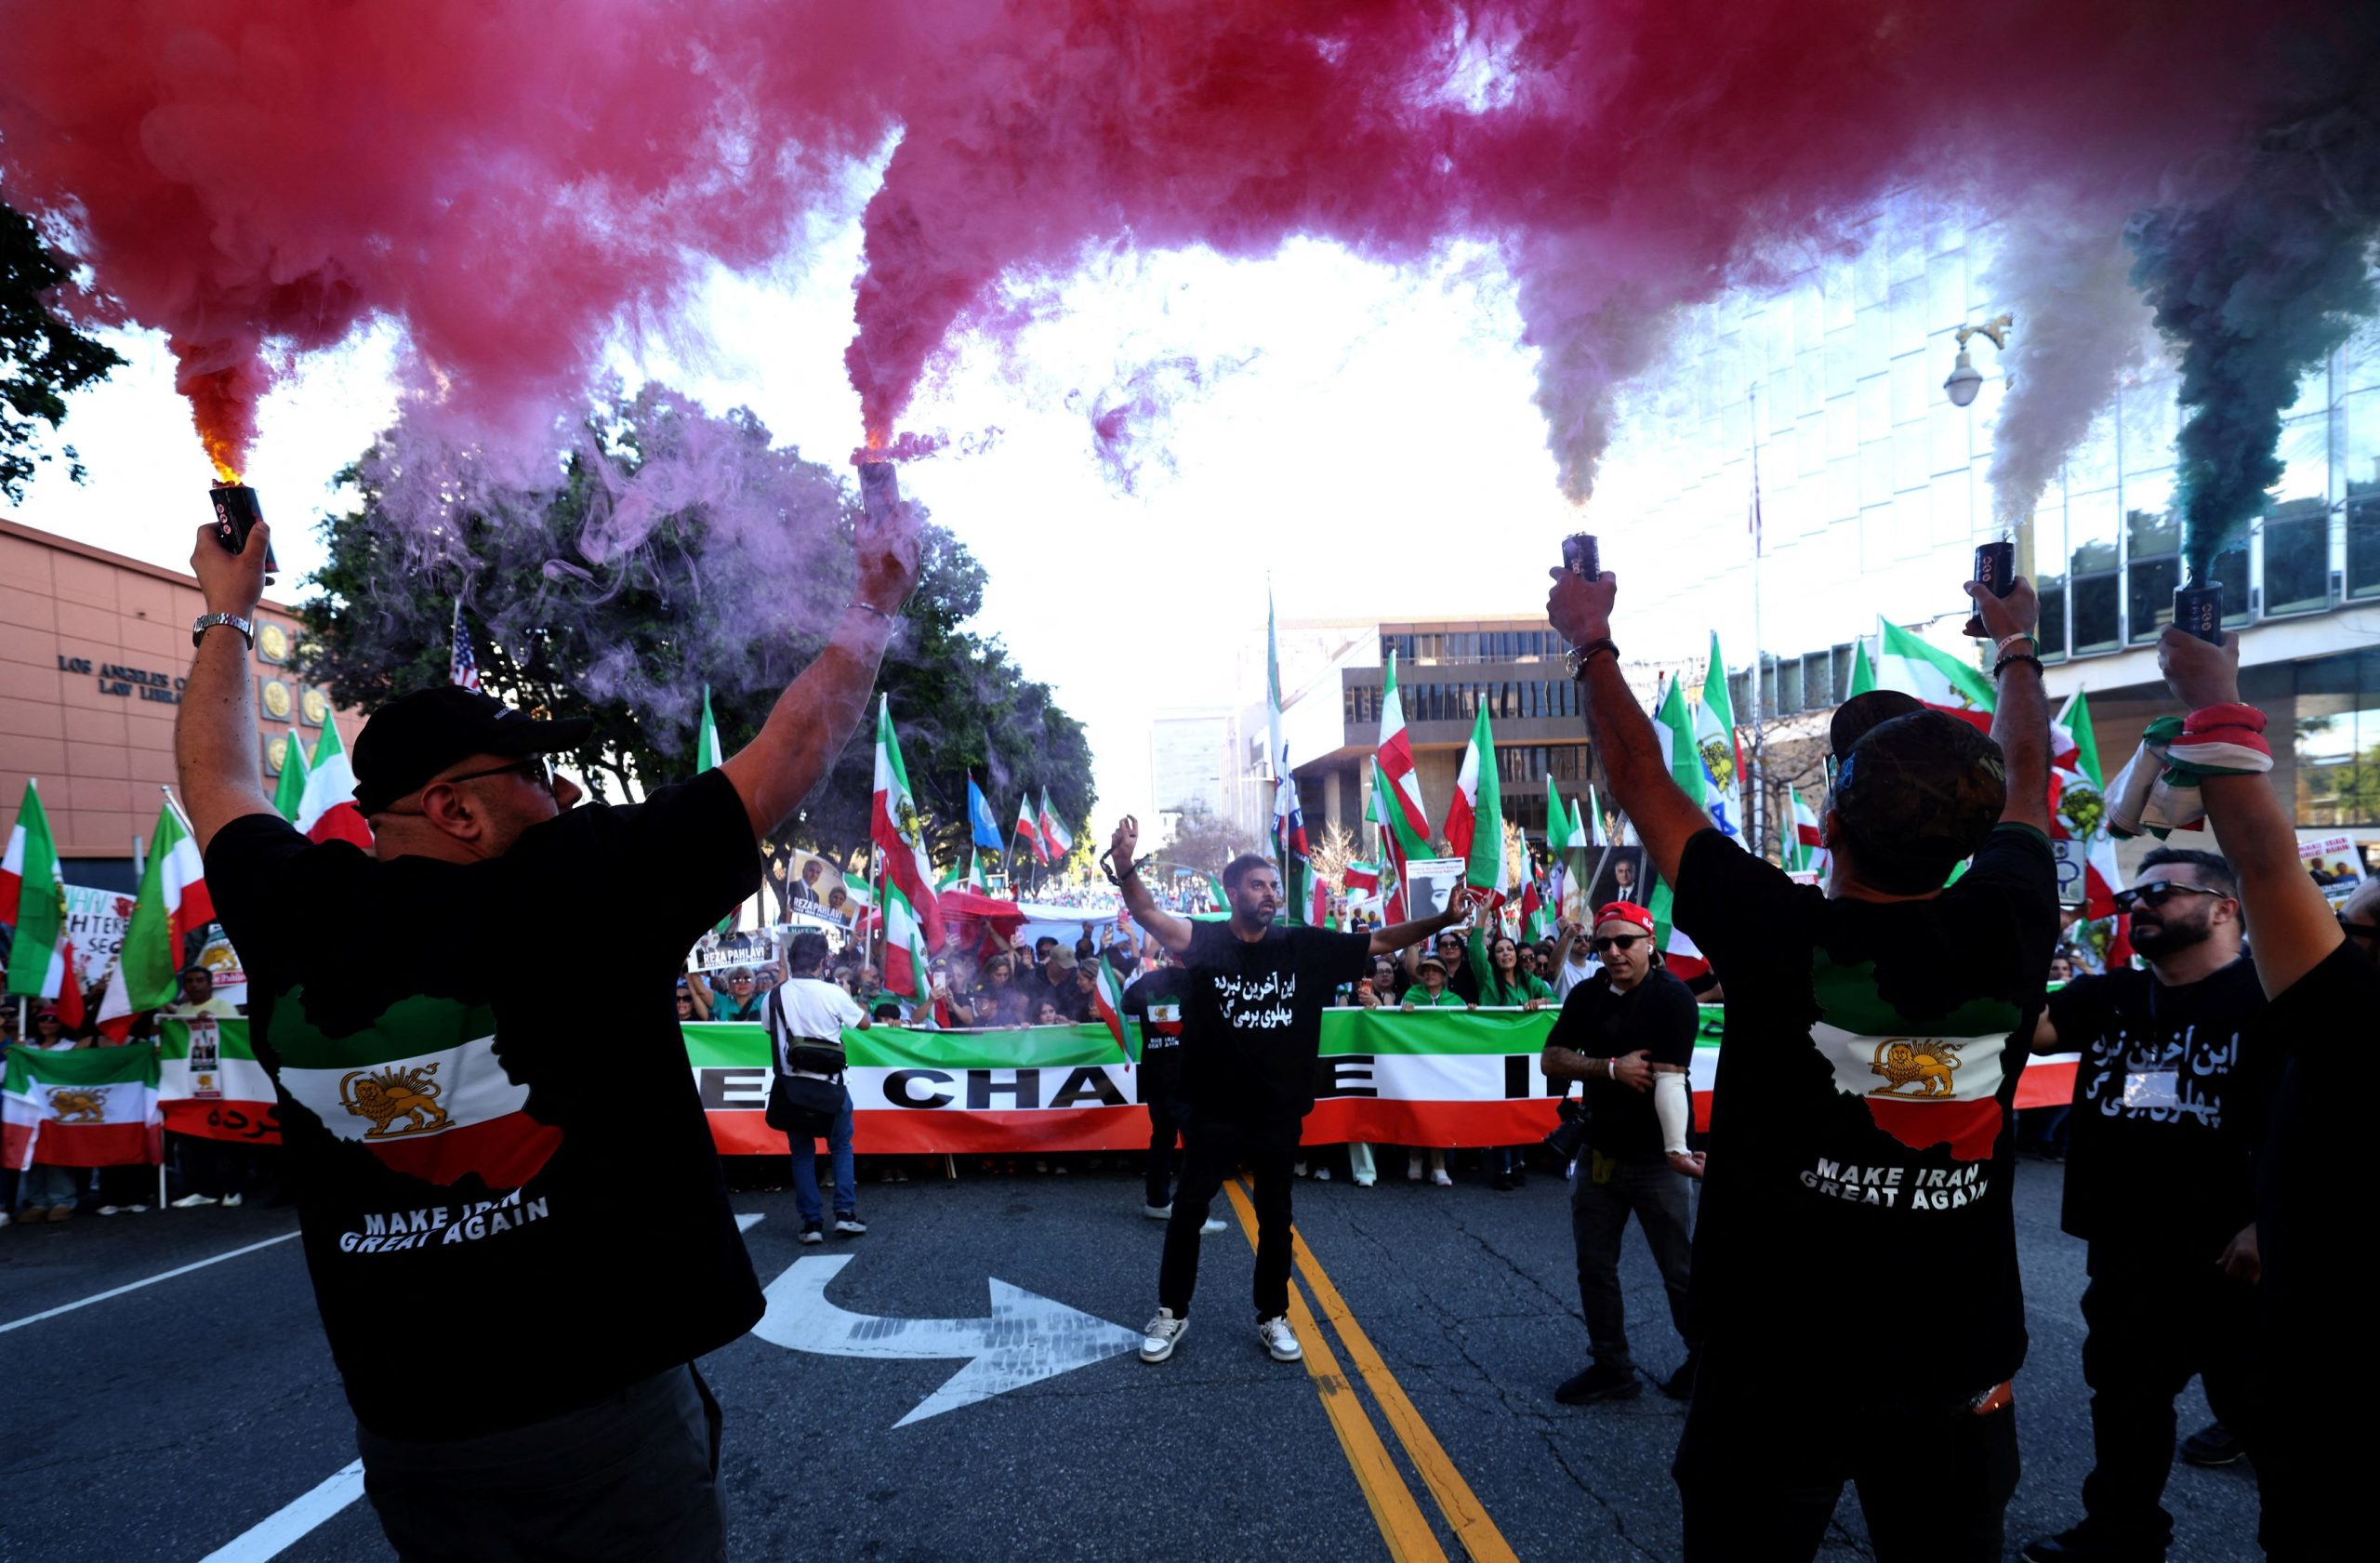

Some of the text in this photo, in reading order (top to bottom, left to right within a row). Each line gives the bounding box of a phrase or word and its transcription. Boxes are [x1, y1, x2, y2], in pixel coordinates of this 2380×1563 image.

[58, 655, 91, 674] LOS
[99, 663, 169, 687] ANGELES
[99, 678, 133, 696] LAW
[794, 896, 843, 920] REZA PAHLAVI
[704, 949, 727, 964] REZA
[728, 946, 764, 960] PAHLAVI
[1242, 971, 1278, 1000] آخرین
[1280, 973, 1295, 1000] این
[1261, 1001, 1292, 1028] پهلوی
[2192, 1032, 2239, 1076] این
[1817, 1158, 1979, 1187] MAKE IRAN
[1800, 1170, 1989, 1210] GREAT AGAIN
[339, 1197, 549, 1252] GREAT AGAIN
[364, 1207, 448, 1236] MAKE
